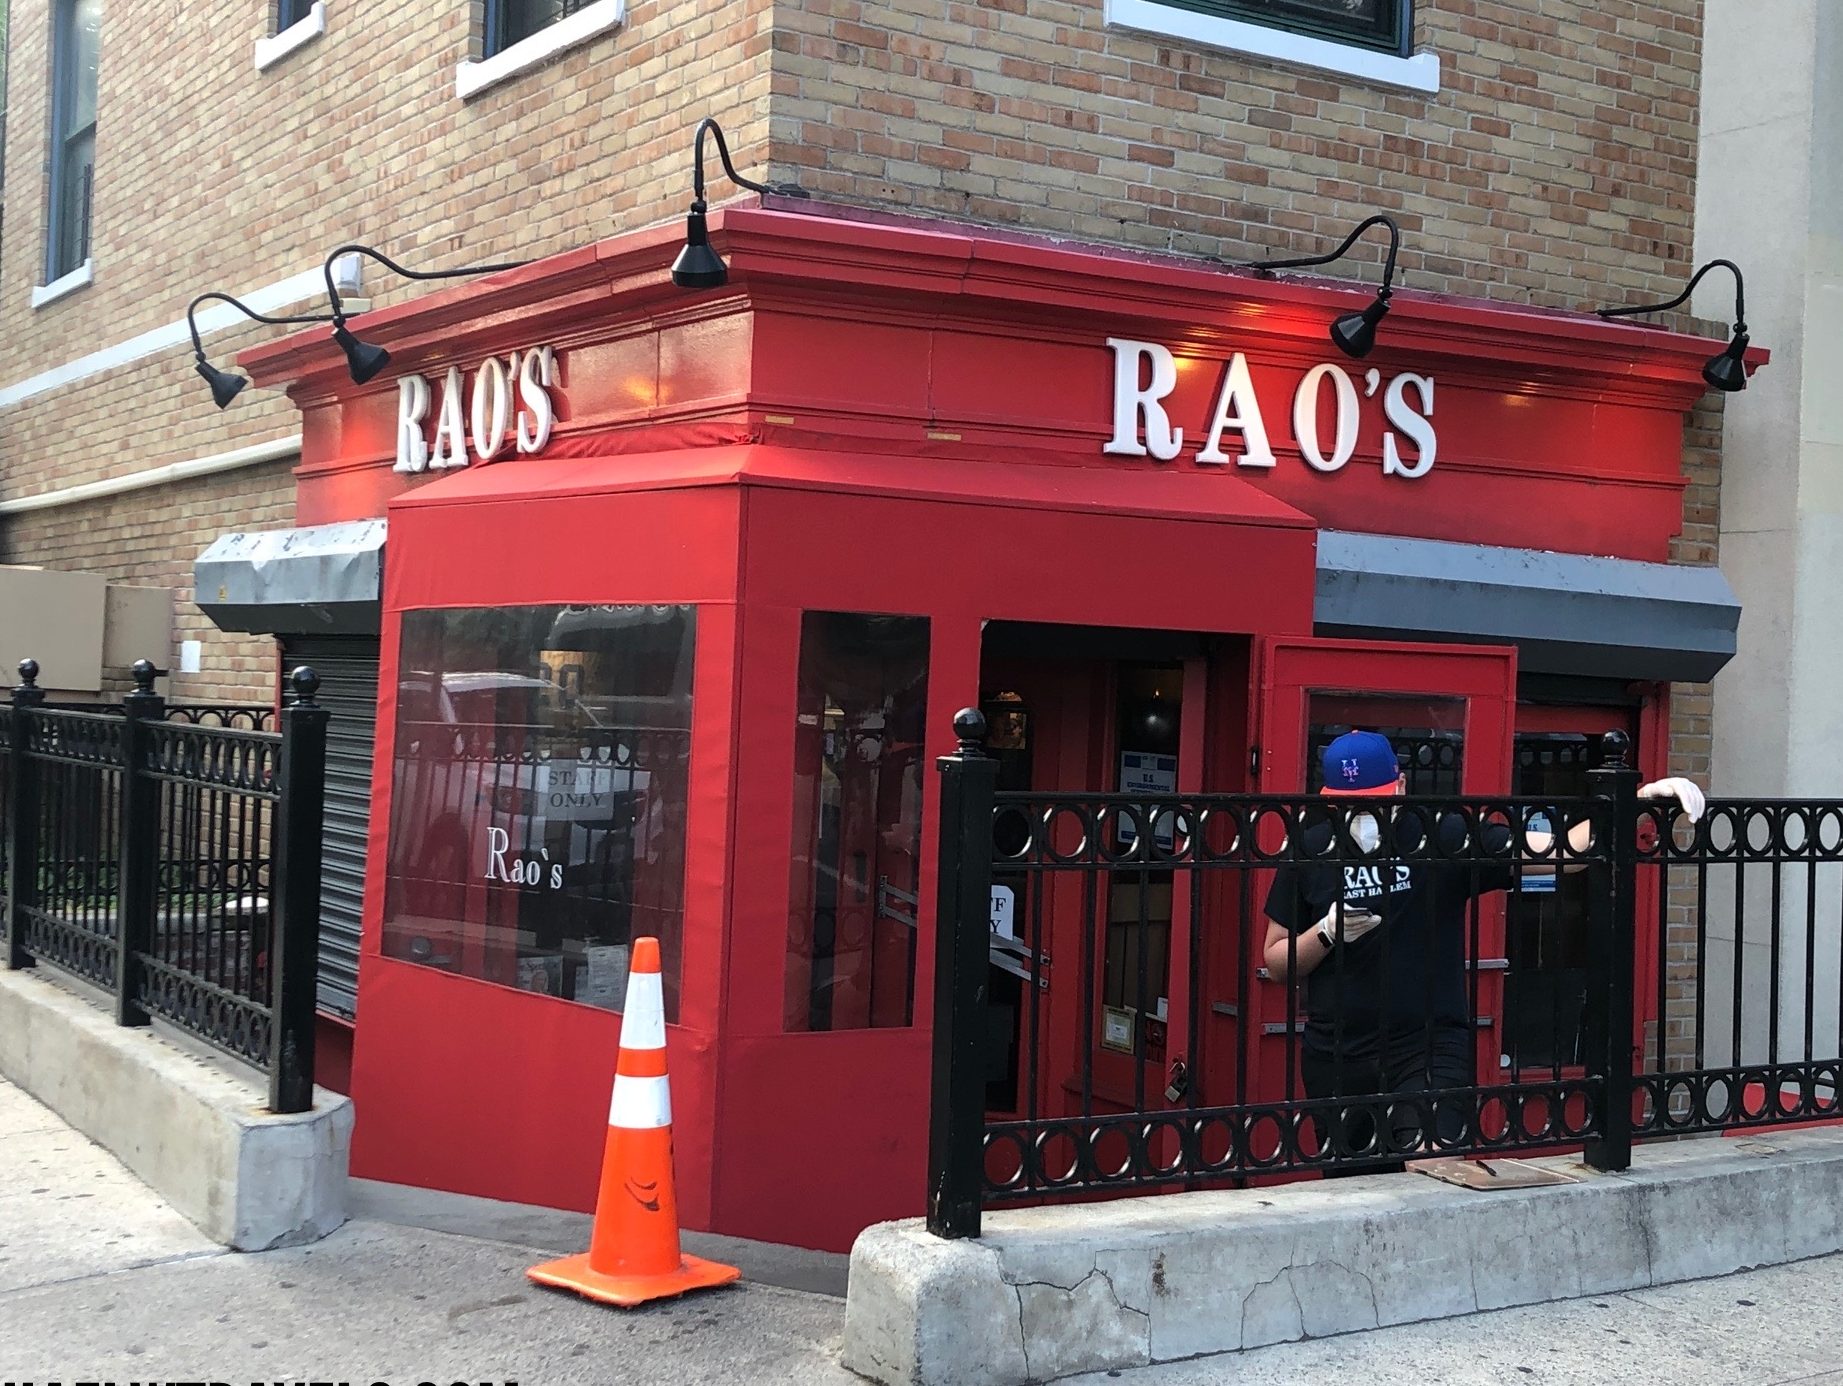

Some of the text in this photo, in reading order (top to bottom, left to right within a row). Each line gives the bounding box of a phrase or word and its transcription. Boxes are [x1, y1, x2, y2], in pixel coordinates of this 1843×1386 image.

[392, 345, 553, 473] RAO'S
[1103, 337, 1437, 478] RAO'S
[550, 792, 604, 808] ONLY
[484, 827, 563, 889] Rao's
[1368, 880, 1412, 897] HALEM
